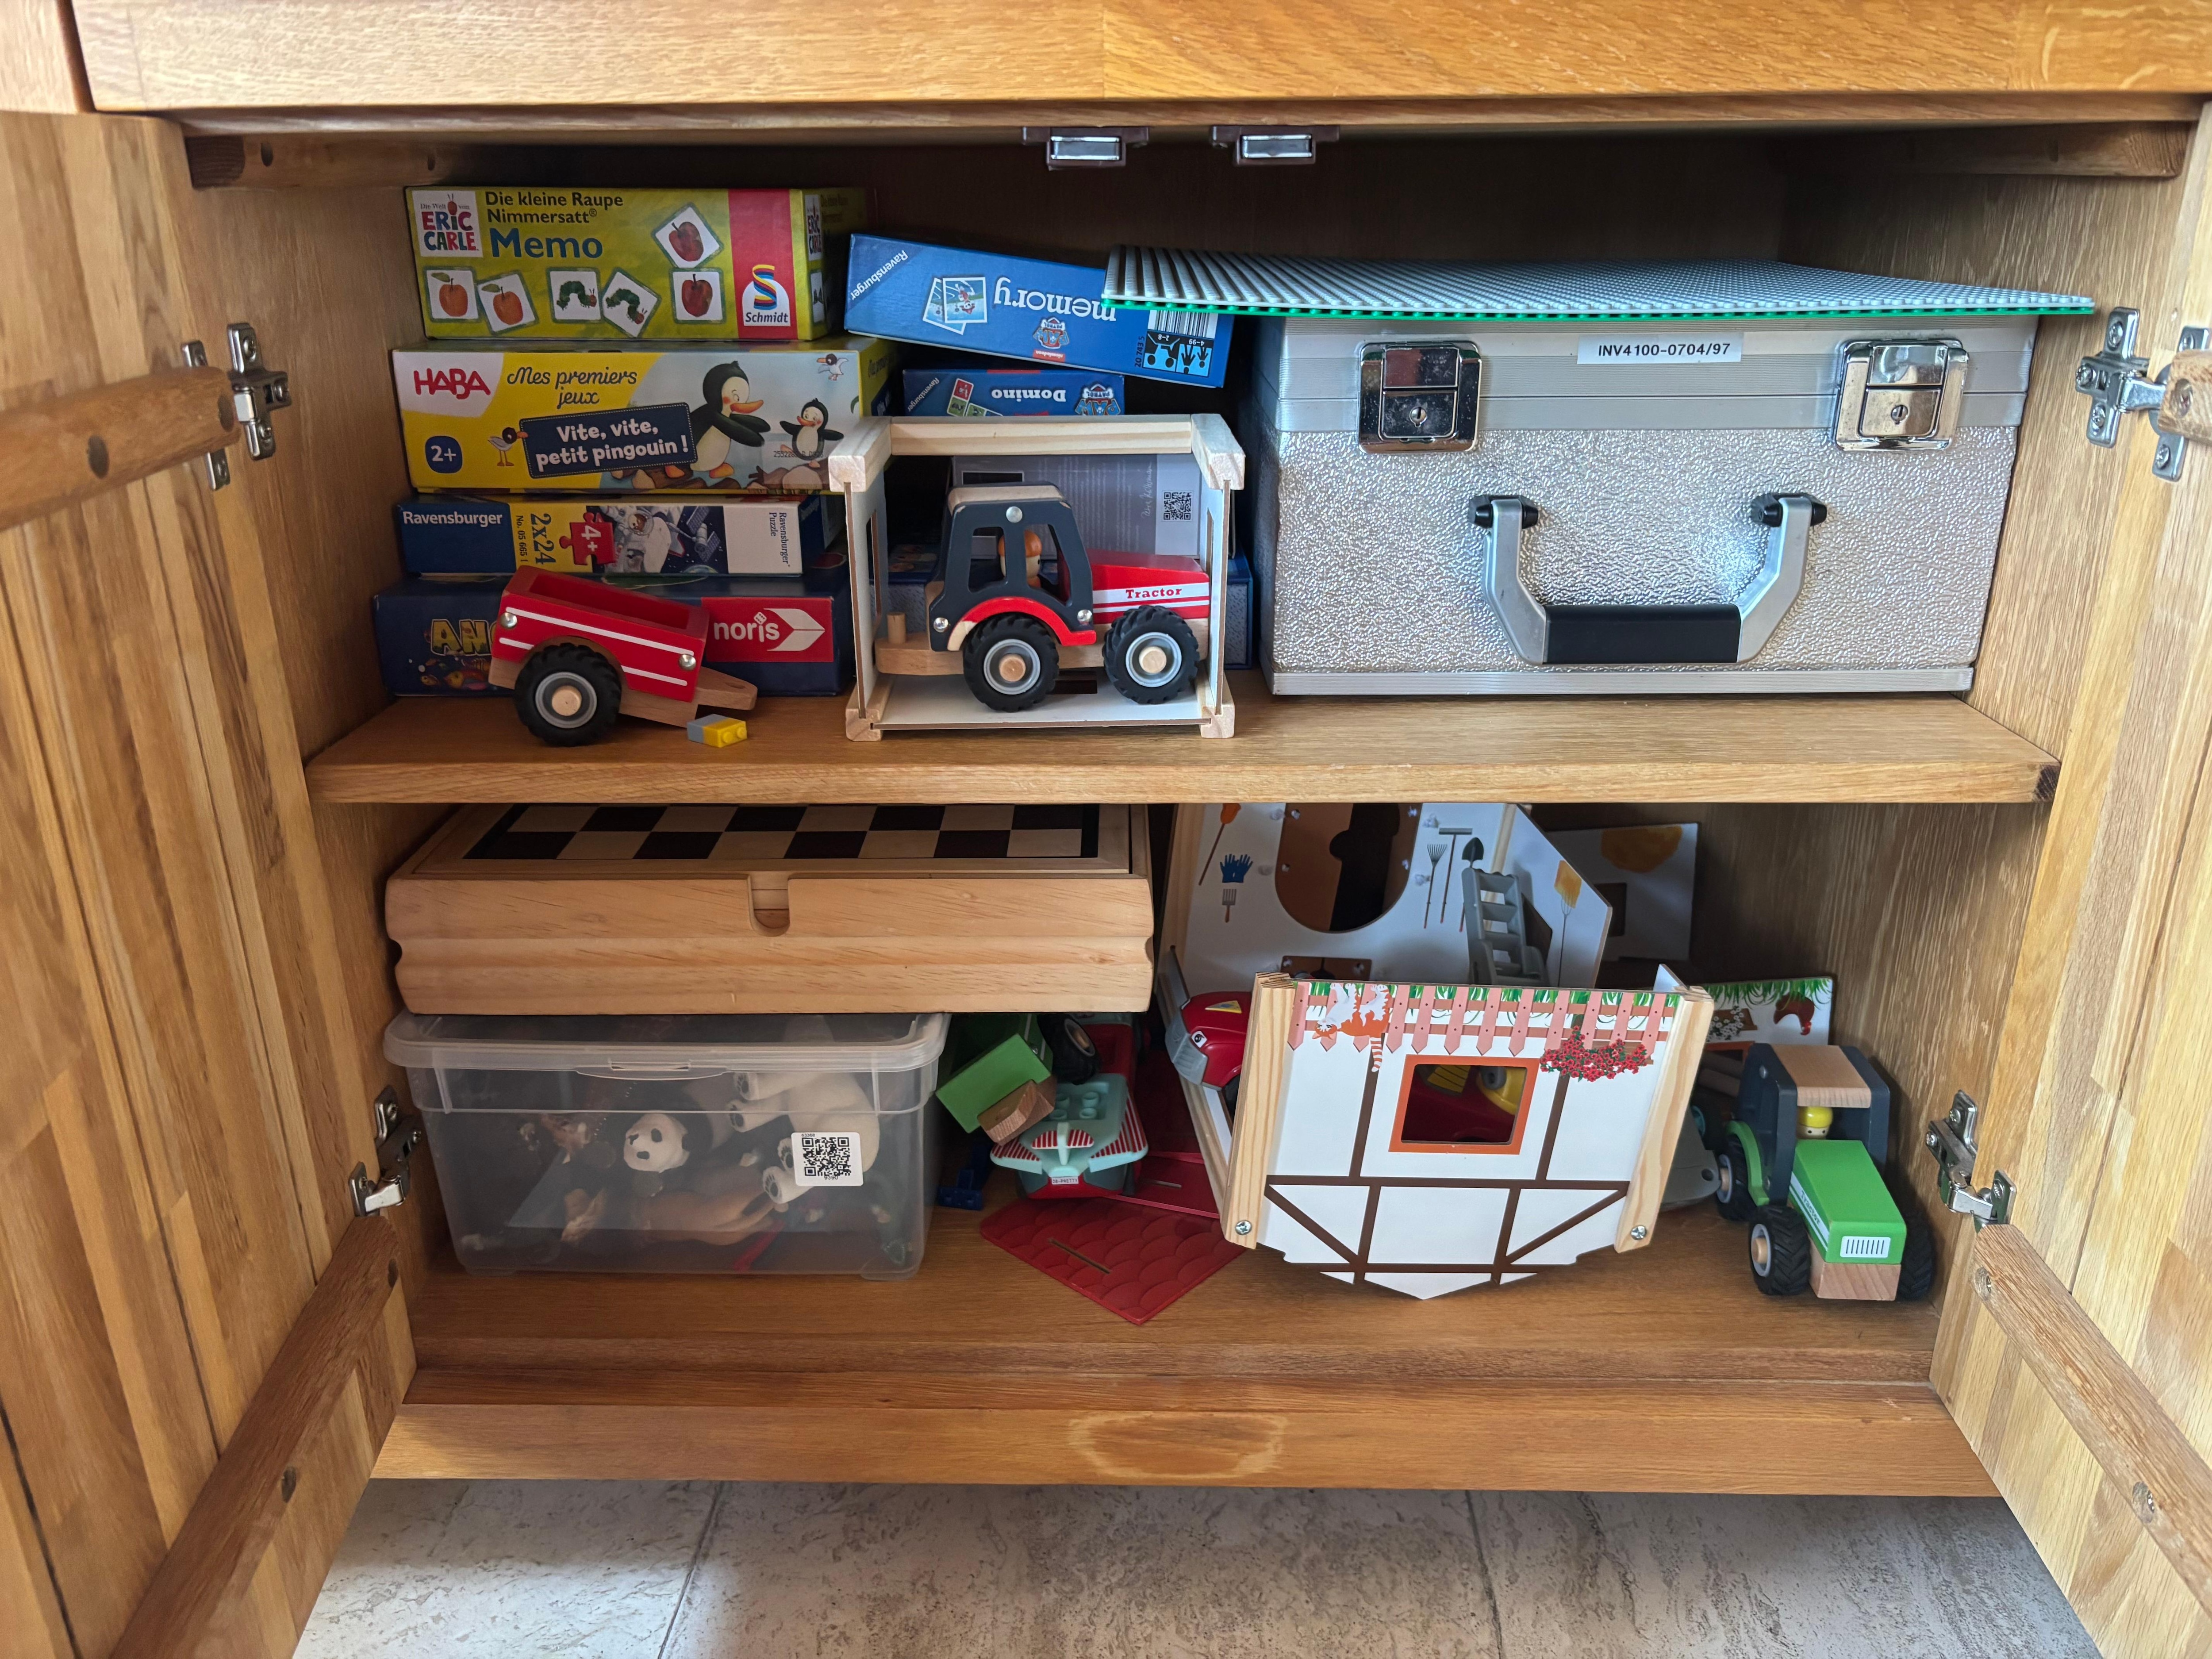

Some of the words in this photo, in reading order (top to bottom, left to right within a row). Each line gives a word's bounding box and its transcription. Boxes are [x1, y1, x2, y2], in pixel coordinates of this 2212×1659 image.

[486, 192, 513, 205] Die
[518, 192, 566, 206] kleine
[572, 192, 623, 210] Raupe
[424, 231, 477, 251] CARLE
[489, 227, 603, 258] Memo
[850, 250, 908, 300] Ravensburger
[745, 312, 788, 323] Schmidt
[1598, 342, 1730, 357] INV4100-0704/97
[414, 368, 491, 399] HABA
[507, 366, 550, 385] Mes
[555, 366, 637, 388] premiers
[557, 387, 600, 409] jeux
[908, 378, 940, 412] Ravensburger
[991, 389, 1066, 402] Domino
[556, 423, 607, 442] Vite,
[611, 418, 658, 436] vite,
[430, 445, 457, 462] 2+
[535, 445, 588, 472] petit
[593, 438, 678, 467] pingouin
[403, 511, 503, 527] Ravensburger
[518, 530, 526, 540] 05
[530, 513, 556, 565] 2x24
[581, 525, 601, 552] 4+
[779, 512, 789, 565] Ravensburger
[1125, 588, 1182, 599] Tractor
[714, 612, 780, 642] noris
[1800, 1190, 1820, 1225] Tractor
